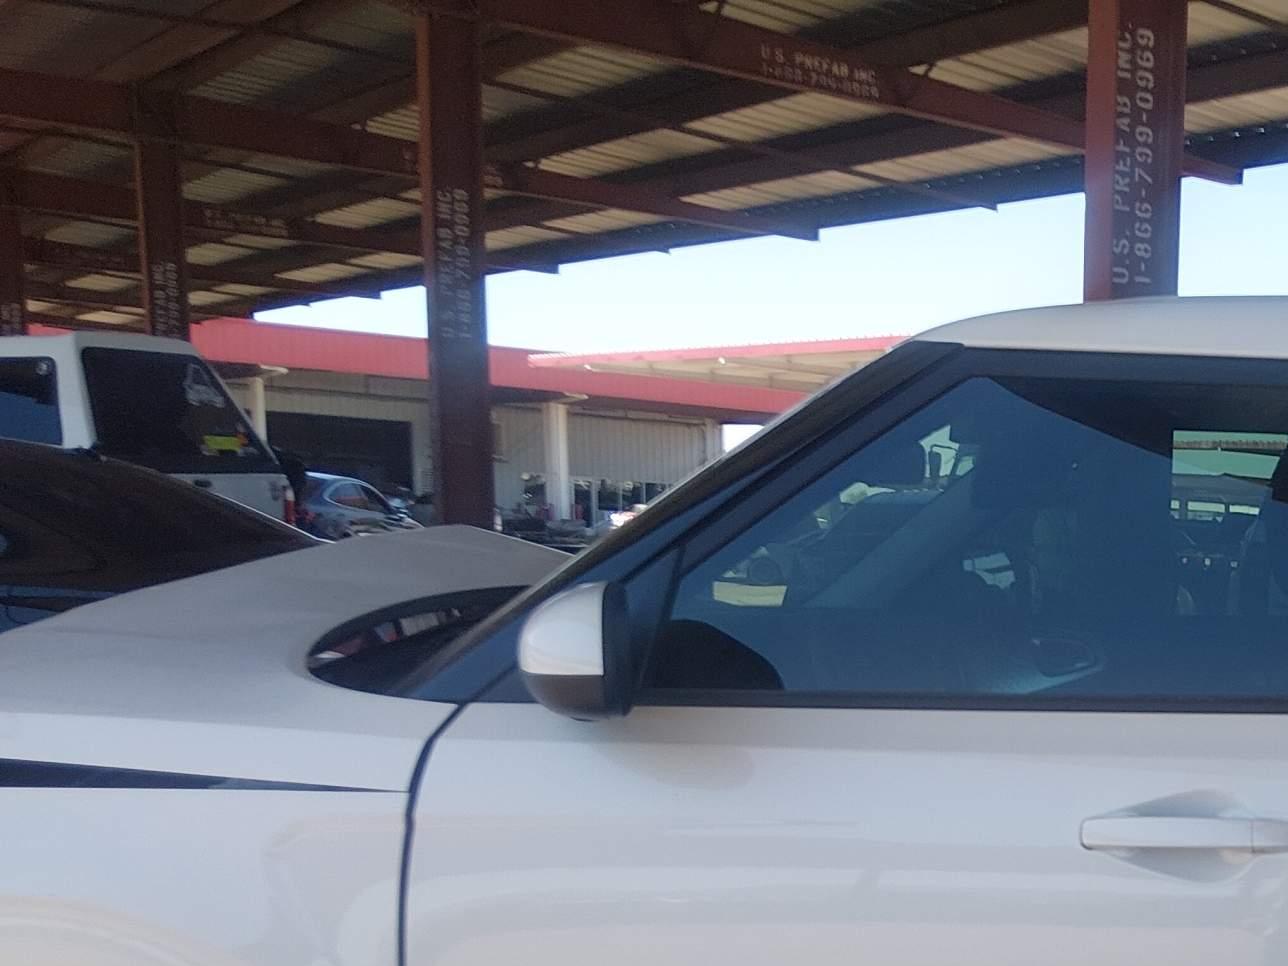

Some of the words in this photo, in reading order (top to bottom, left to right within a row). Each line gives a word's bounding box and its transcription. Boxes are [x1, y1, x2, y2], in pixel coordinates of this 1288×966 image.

[1117, 21, 1134, 80] INC.
[1114, 95, 1132, 212] PREFAB
[1135, 27, 1155, 285] 1-866-799-0969
[1112, 230, 1131, 285] U.S.
